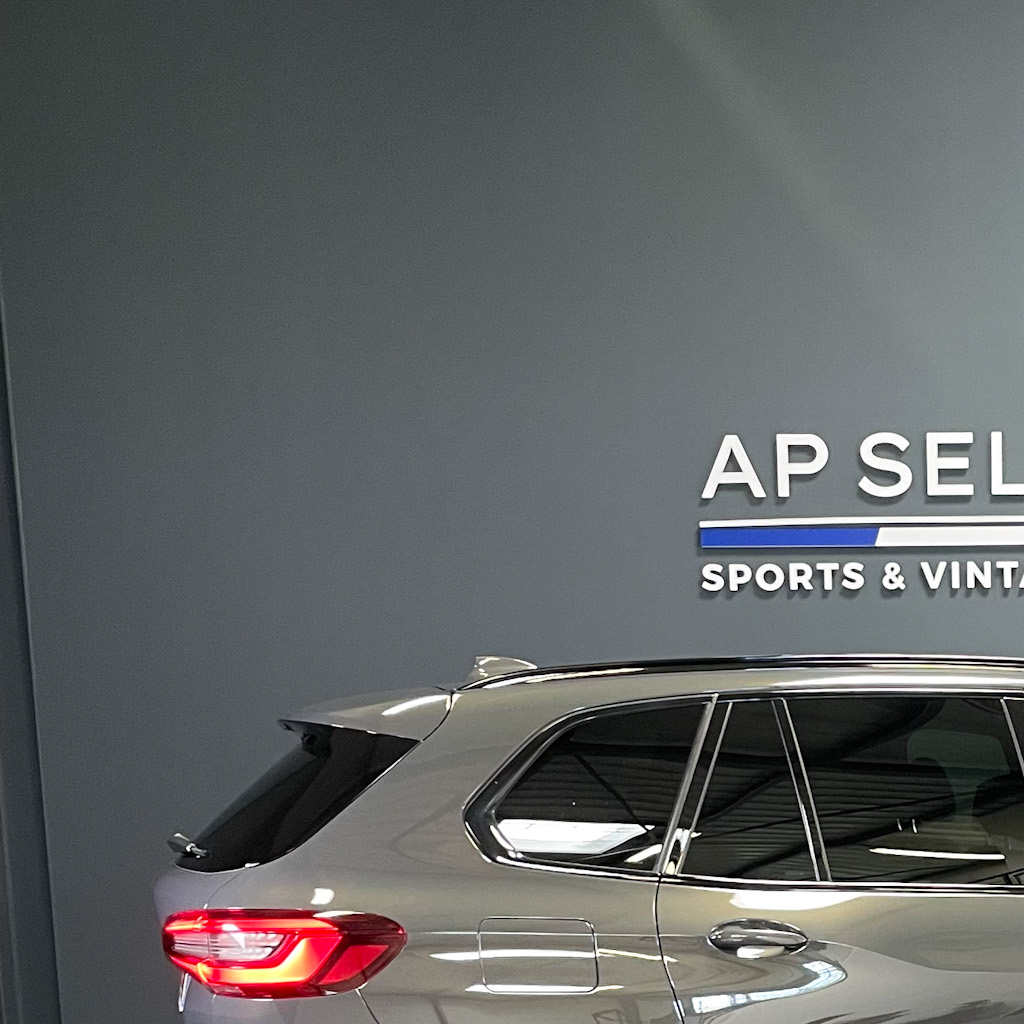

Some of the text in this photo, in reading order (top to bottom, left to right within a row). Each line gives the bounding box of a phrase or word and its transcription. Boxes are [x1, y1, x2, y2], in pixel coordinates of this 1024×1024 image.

[701, 433, 829, 499] AP
[701, 561, 865, 592] SPORTS
[882, 561, 907, 590] &
